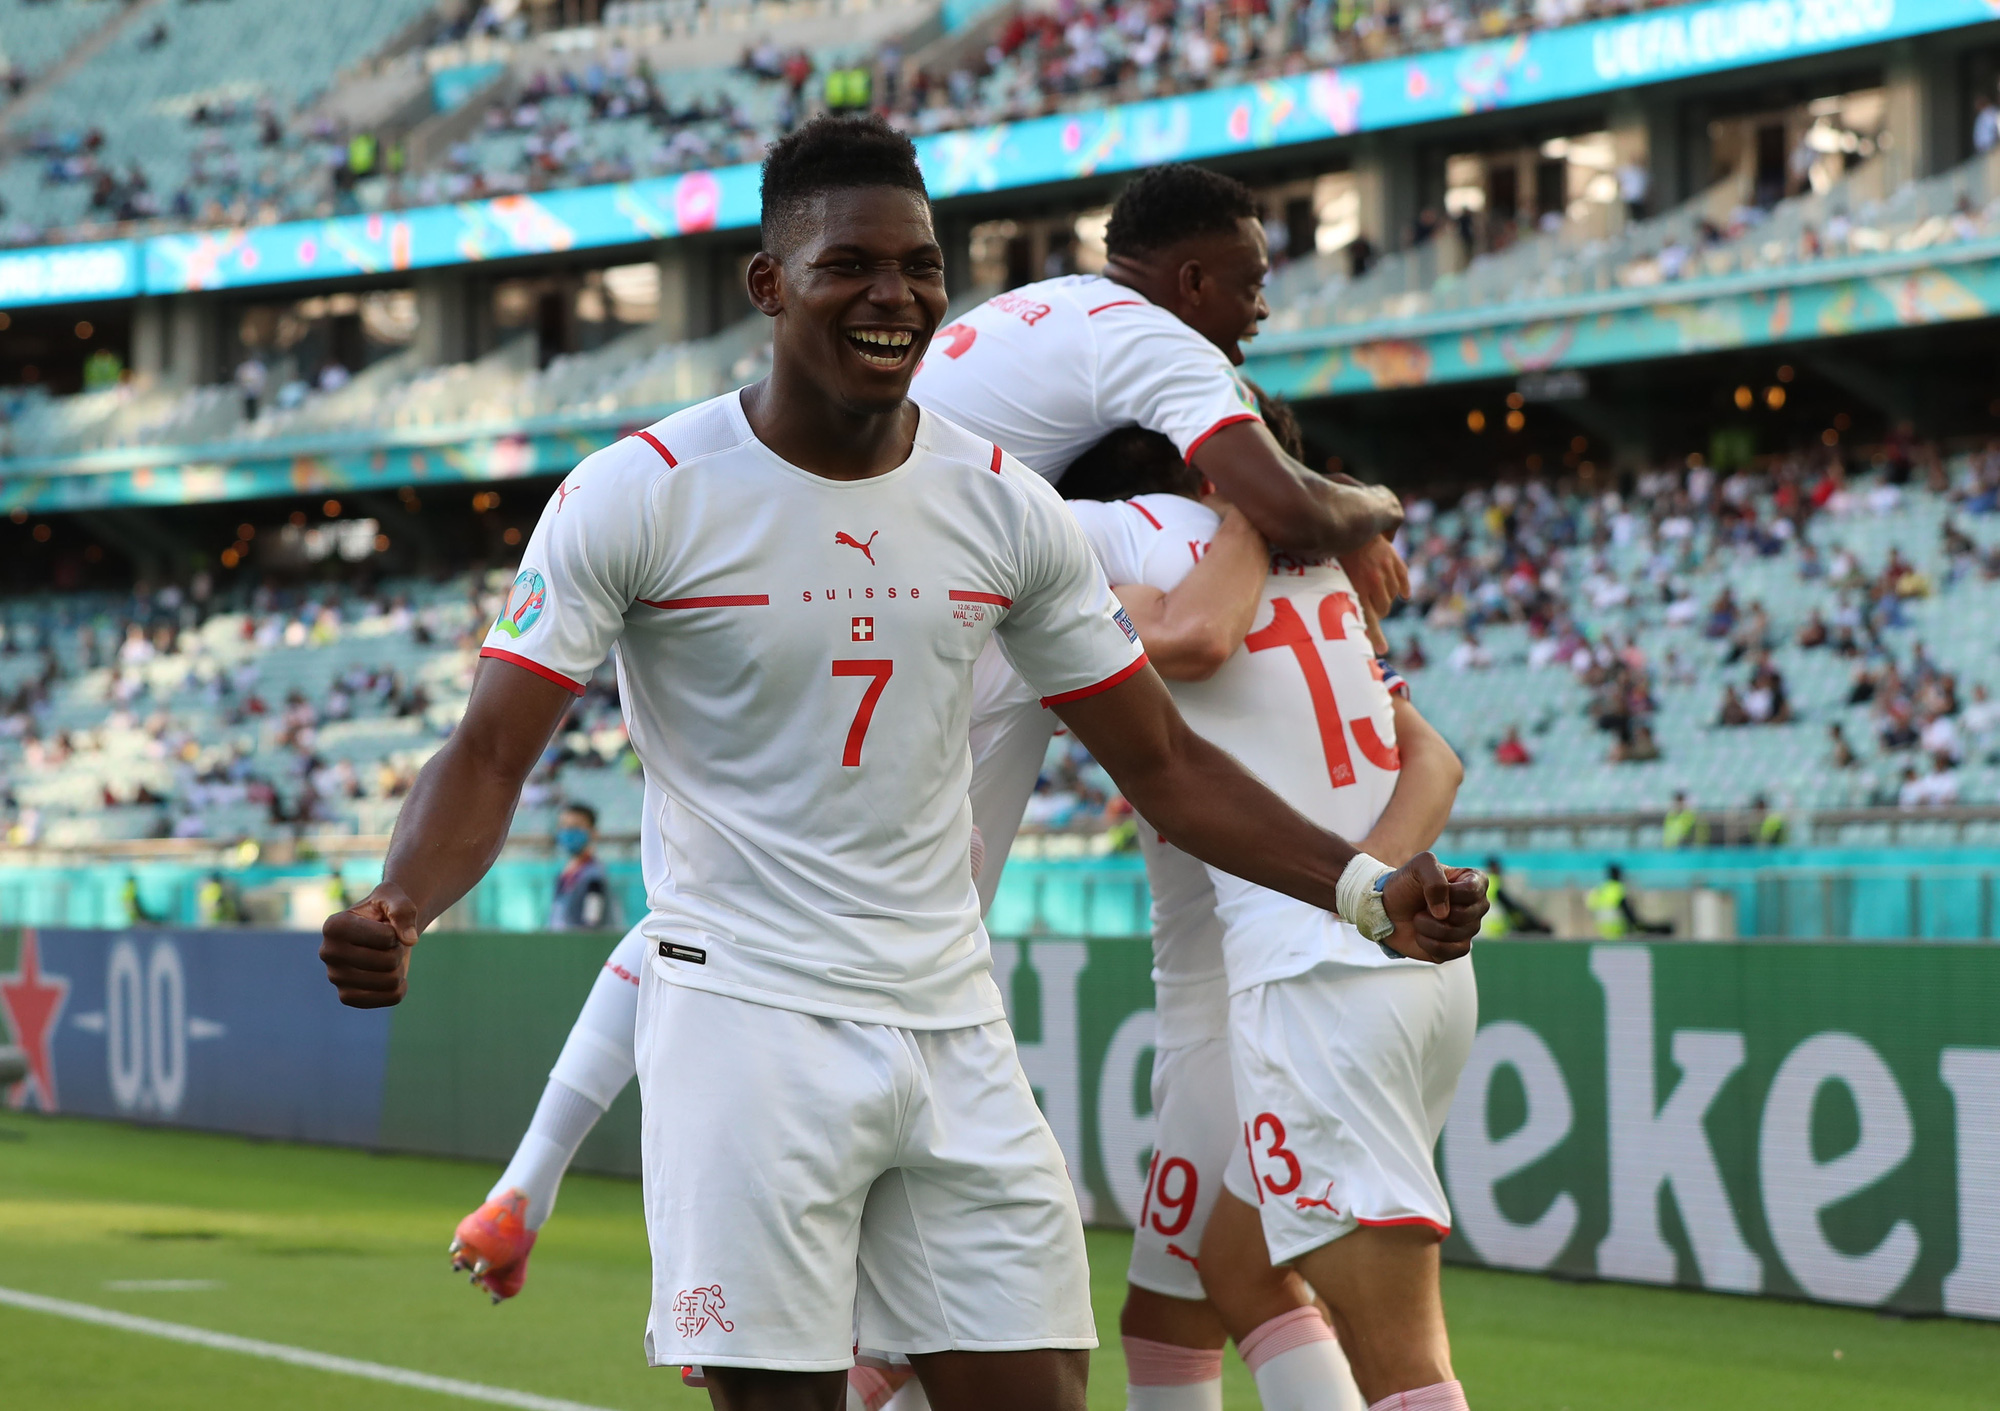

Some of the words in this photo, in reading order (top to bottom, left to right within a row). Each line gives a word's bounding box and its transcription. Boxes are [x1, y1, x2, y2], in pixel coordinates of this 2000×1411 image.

[1593, 16, 1692, 80] UEFA
[1689, 2, 1794, 63] EURO
[802, 587, 920, 602] suisse
[952, 610, 968, 620] WAL
[973, 612, 985, 621] SUI
[957, 604, 982, 612] 12.06.2021
[831, 659, 894, 767] 7
